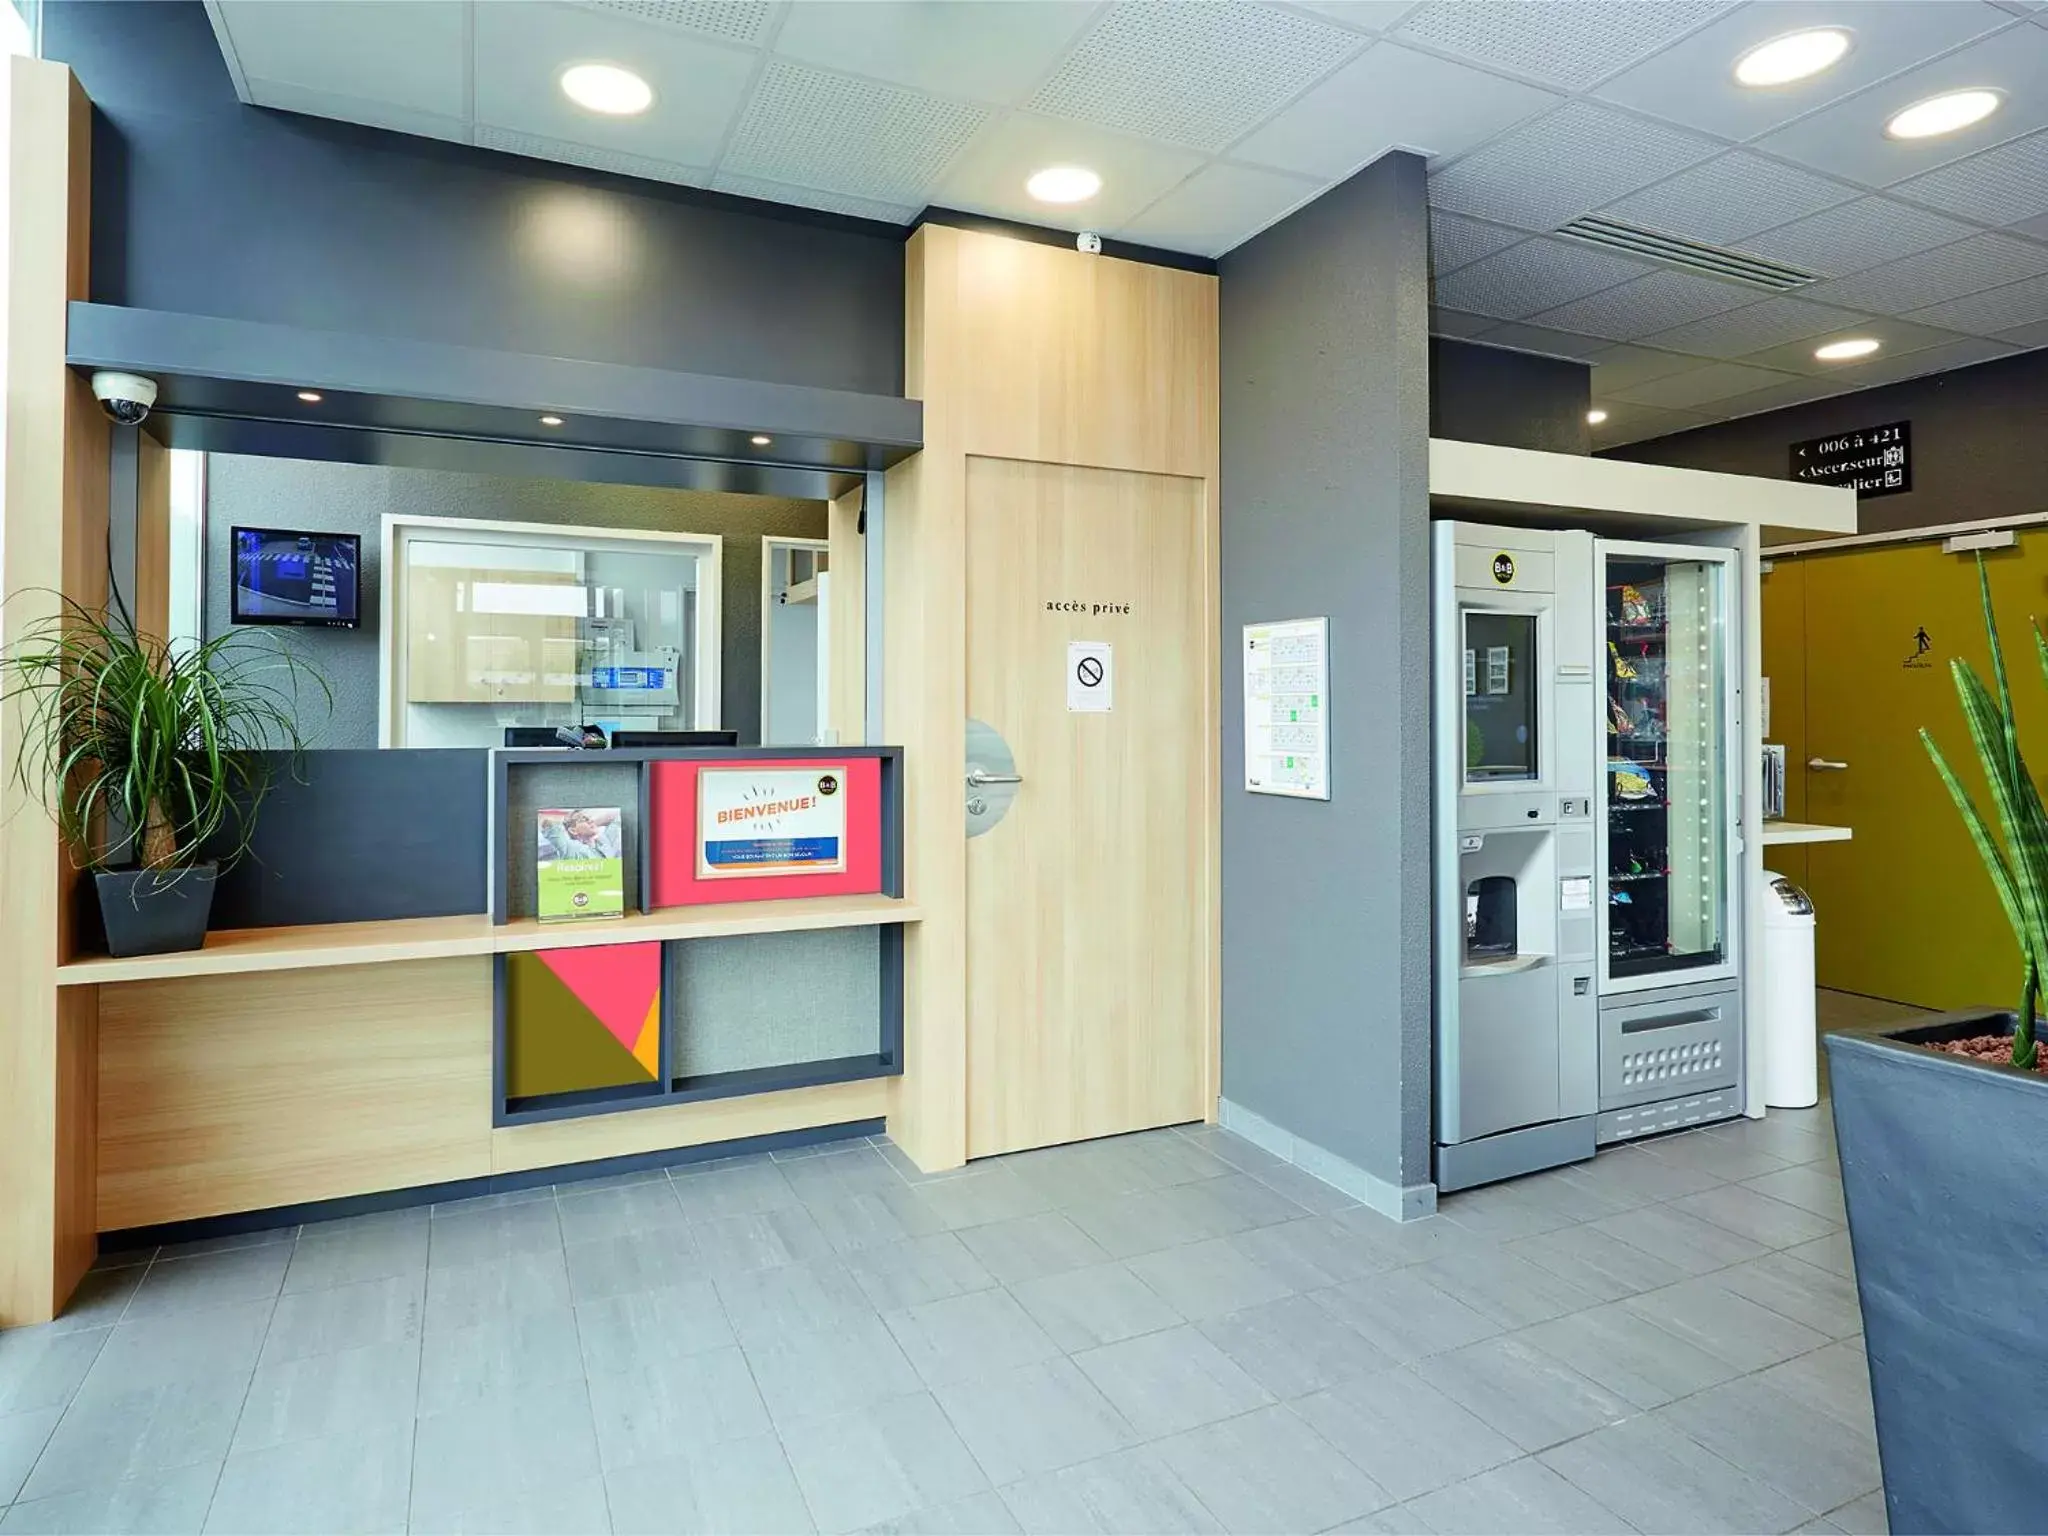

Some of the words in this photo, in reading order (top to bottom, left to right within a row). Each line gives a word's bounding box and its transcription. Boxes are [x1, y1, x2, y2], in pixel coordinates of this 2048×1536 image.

[1819, 438, 1850, 454] 006
[1854, 435, 1864, 448] à
[1869, 428, 1901, 444] 421
[1046, 600, 1087, 612] accès
[1092, 602, 1130, 616] privé
